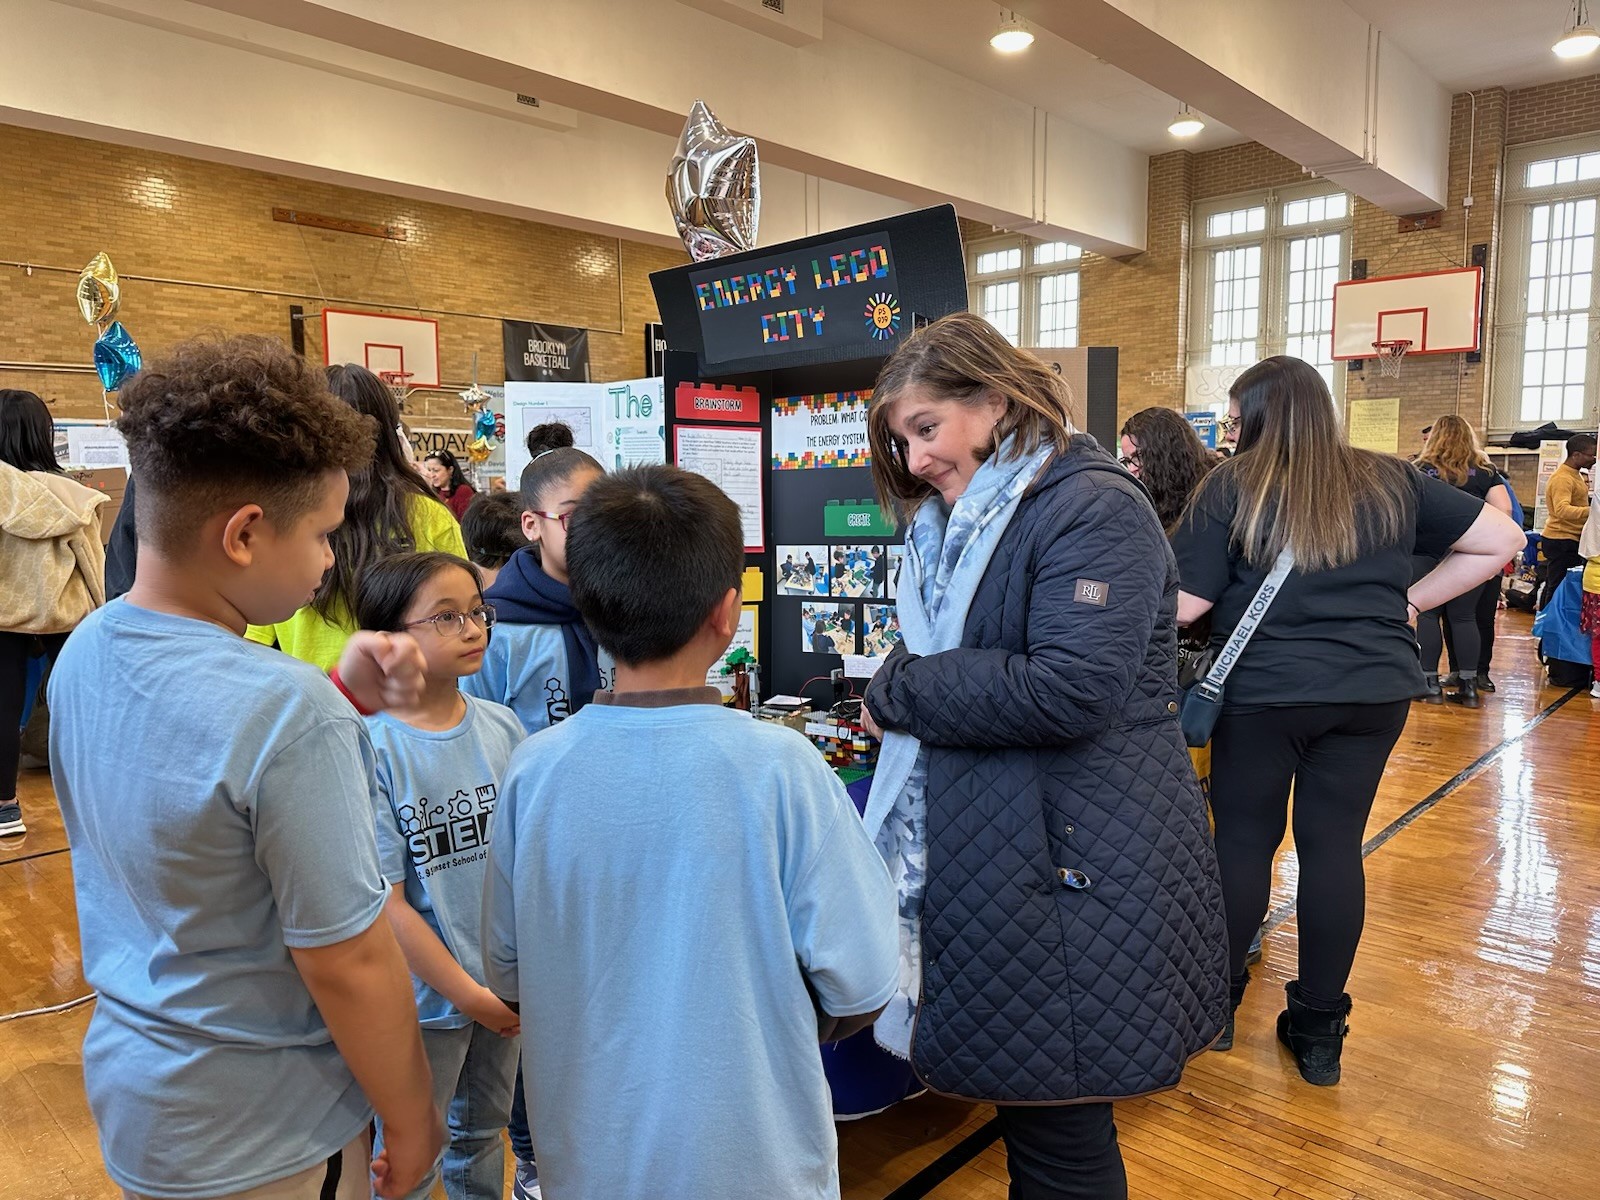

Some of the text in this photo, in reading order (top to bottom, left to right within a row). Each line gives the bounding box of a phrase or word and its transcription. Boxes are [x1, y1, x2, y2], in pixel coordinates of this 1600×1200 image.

[695, 245, 890, 311] ENERGY LEGO
[878, 307, 887, 316] PS
[761, 305, 826, 343] CITY
[527, 338, 567, 356] BROOKLYN
[523, 352, 571, 370] BASKETBALL
[608, 384, 653, 419] The
[694, 396, 743, 412] BRAINSTORM
[841, 411, 857, 424] WHAT
[806, 432, 865, 448] THE ENERGY SYSTEM
[847, 513, 871, 527] CREATE
[1211, 584, 1276, 681] MICHAEL KORS
[452, 852, 478, 867] School
[479, 849, 487, 860] of
